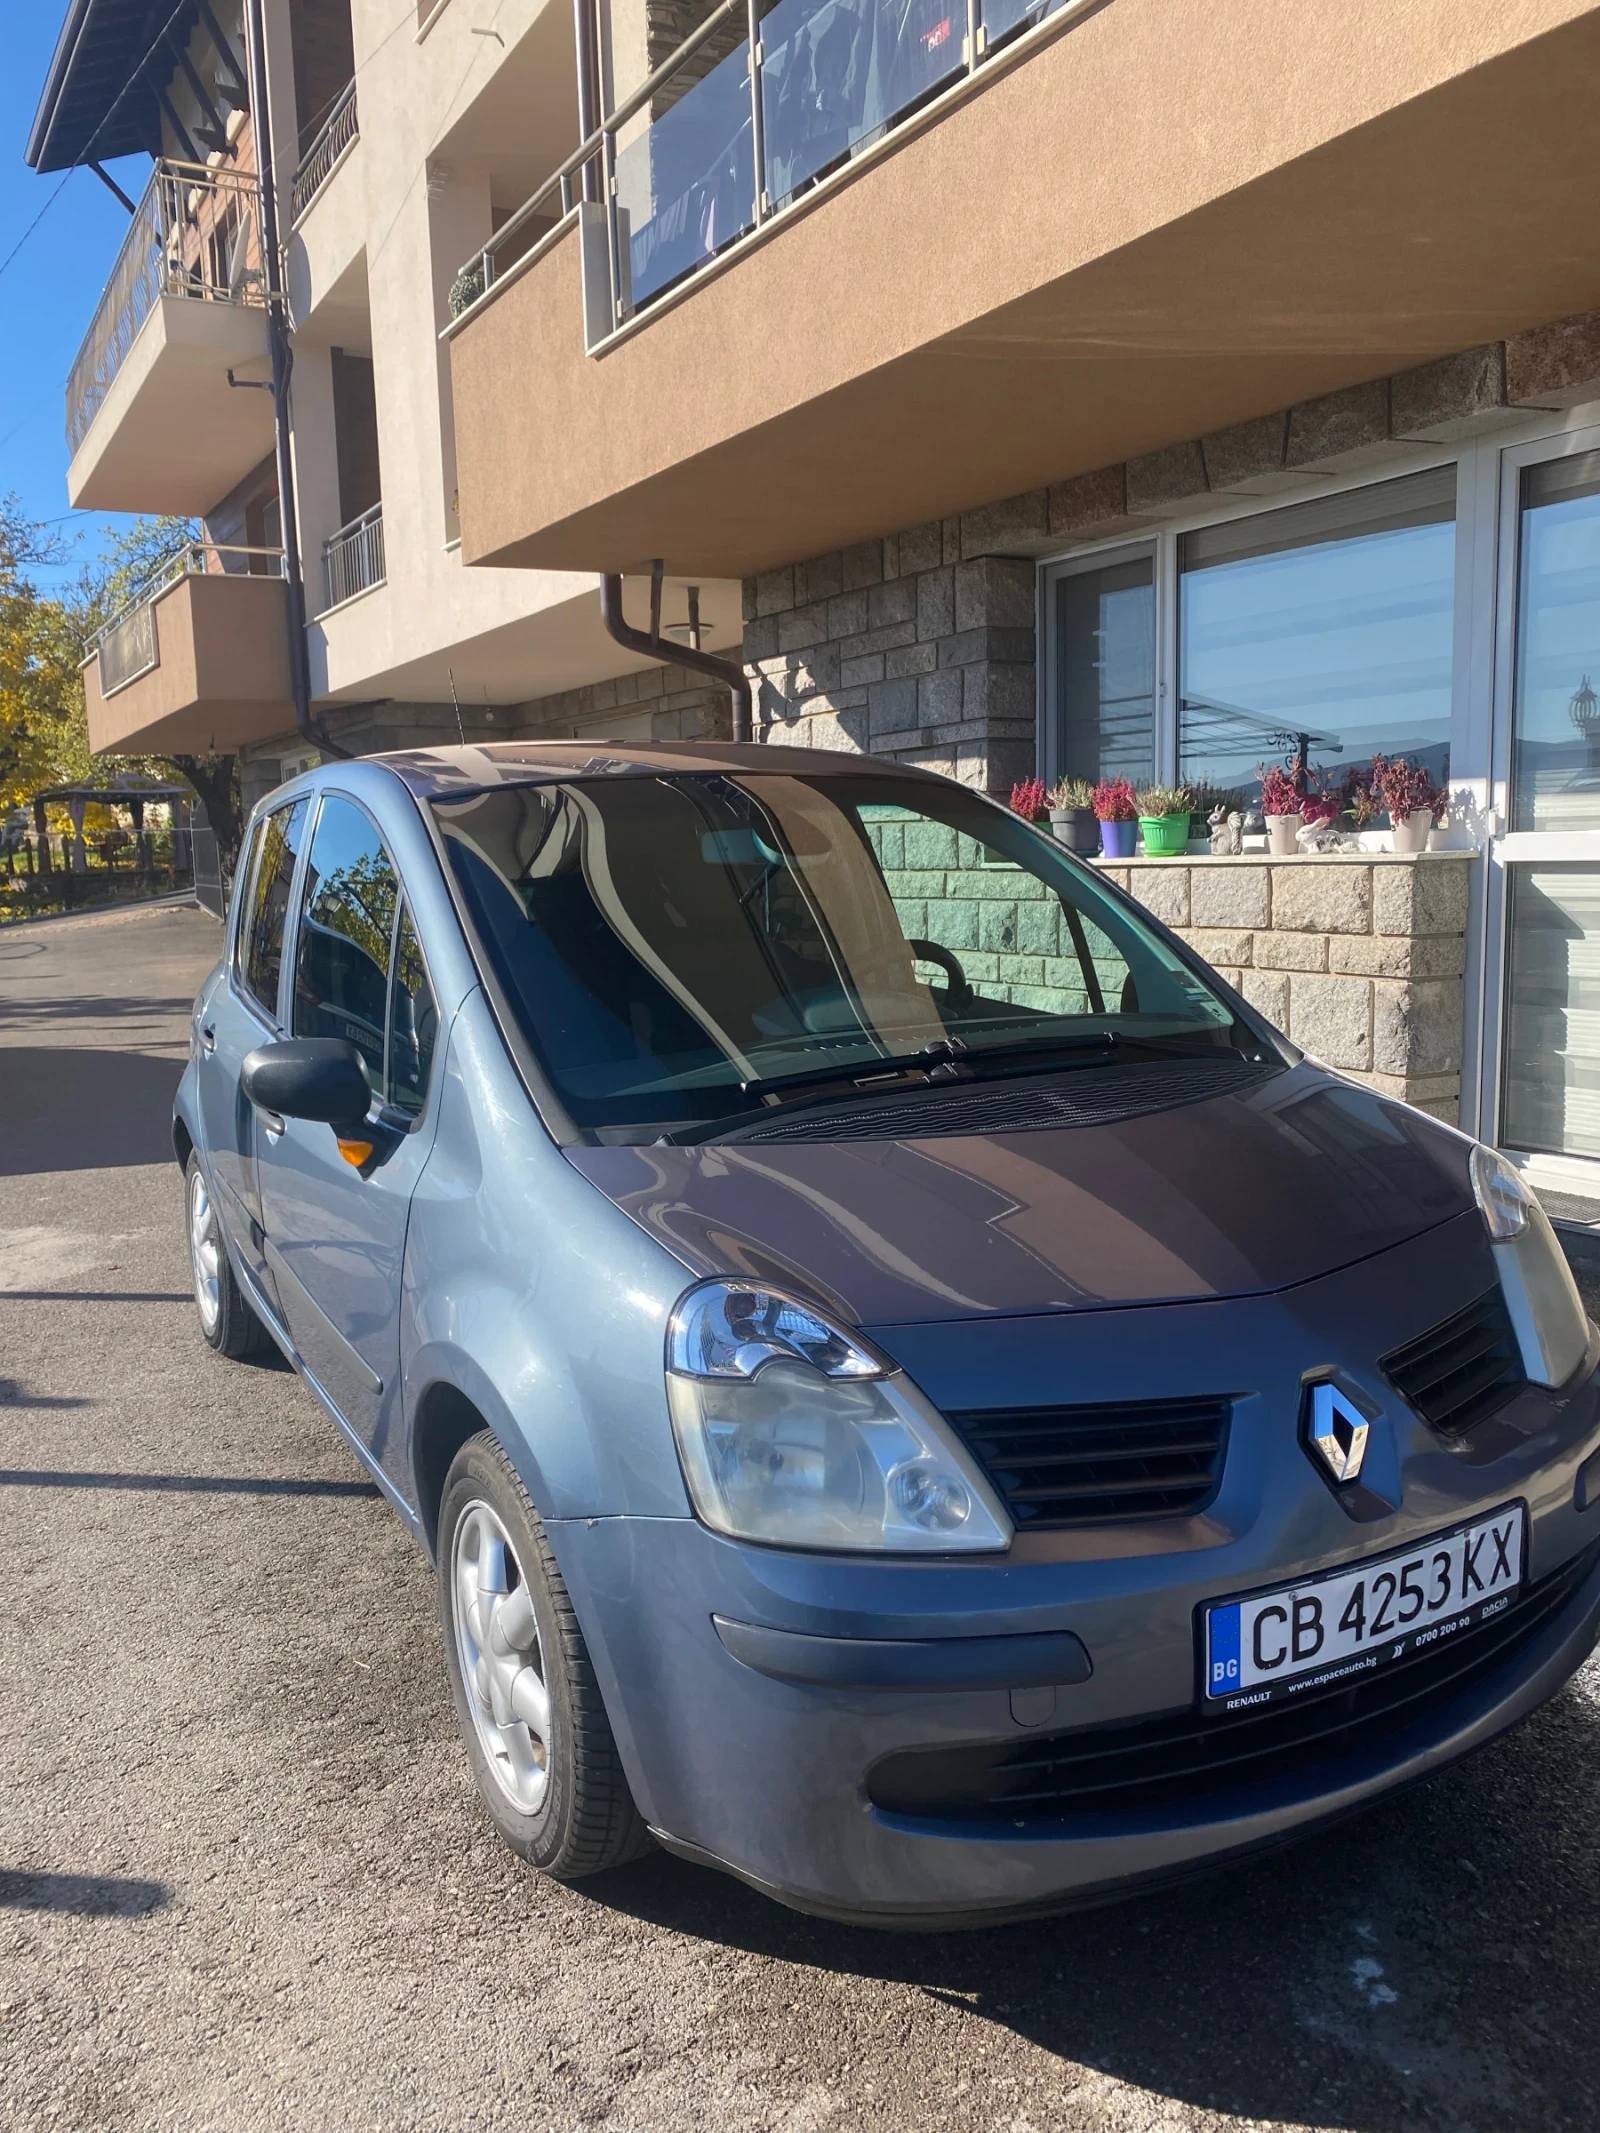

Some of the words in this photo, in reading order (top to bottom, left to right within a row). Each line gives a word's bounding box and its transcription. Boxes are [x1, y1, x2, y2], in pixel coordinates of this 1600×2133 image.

[1252, 1596, 1325, 1671] CB
[1338, 1551, 1451, 1642] 4253
[1461, 1520, 1514, 1599] KX
[1481, 1596, 1509, 1616] DACIA
[1415, 1628, 1438, 1648] 0700
[1439, 1621, 1457, 1639] 200
[1458, 1616, 1471, 1633] 90
[1213, 1658, 1238, 1682] BG
[1288, 1656, 1378, 1693] www.espaceauto.bg
[1226, 1690, 1272, 1710] RENAULT
